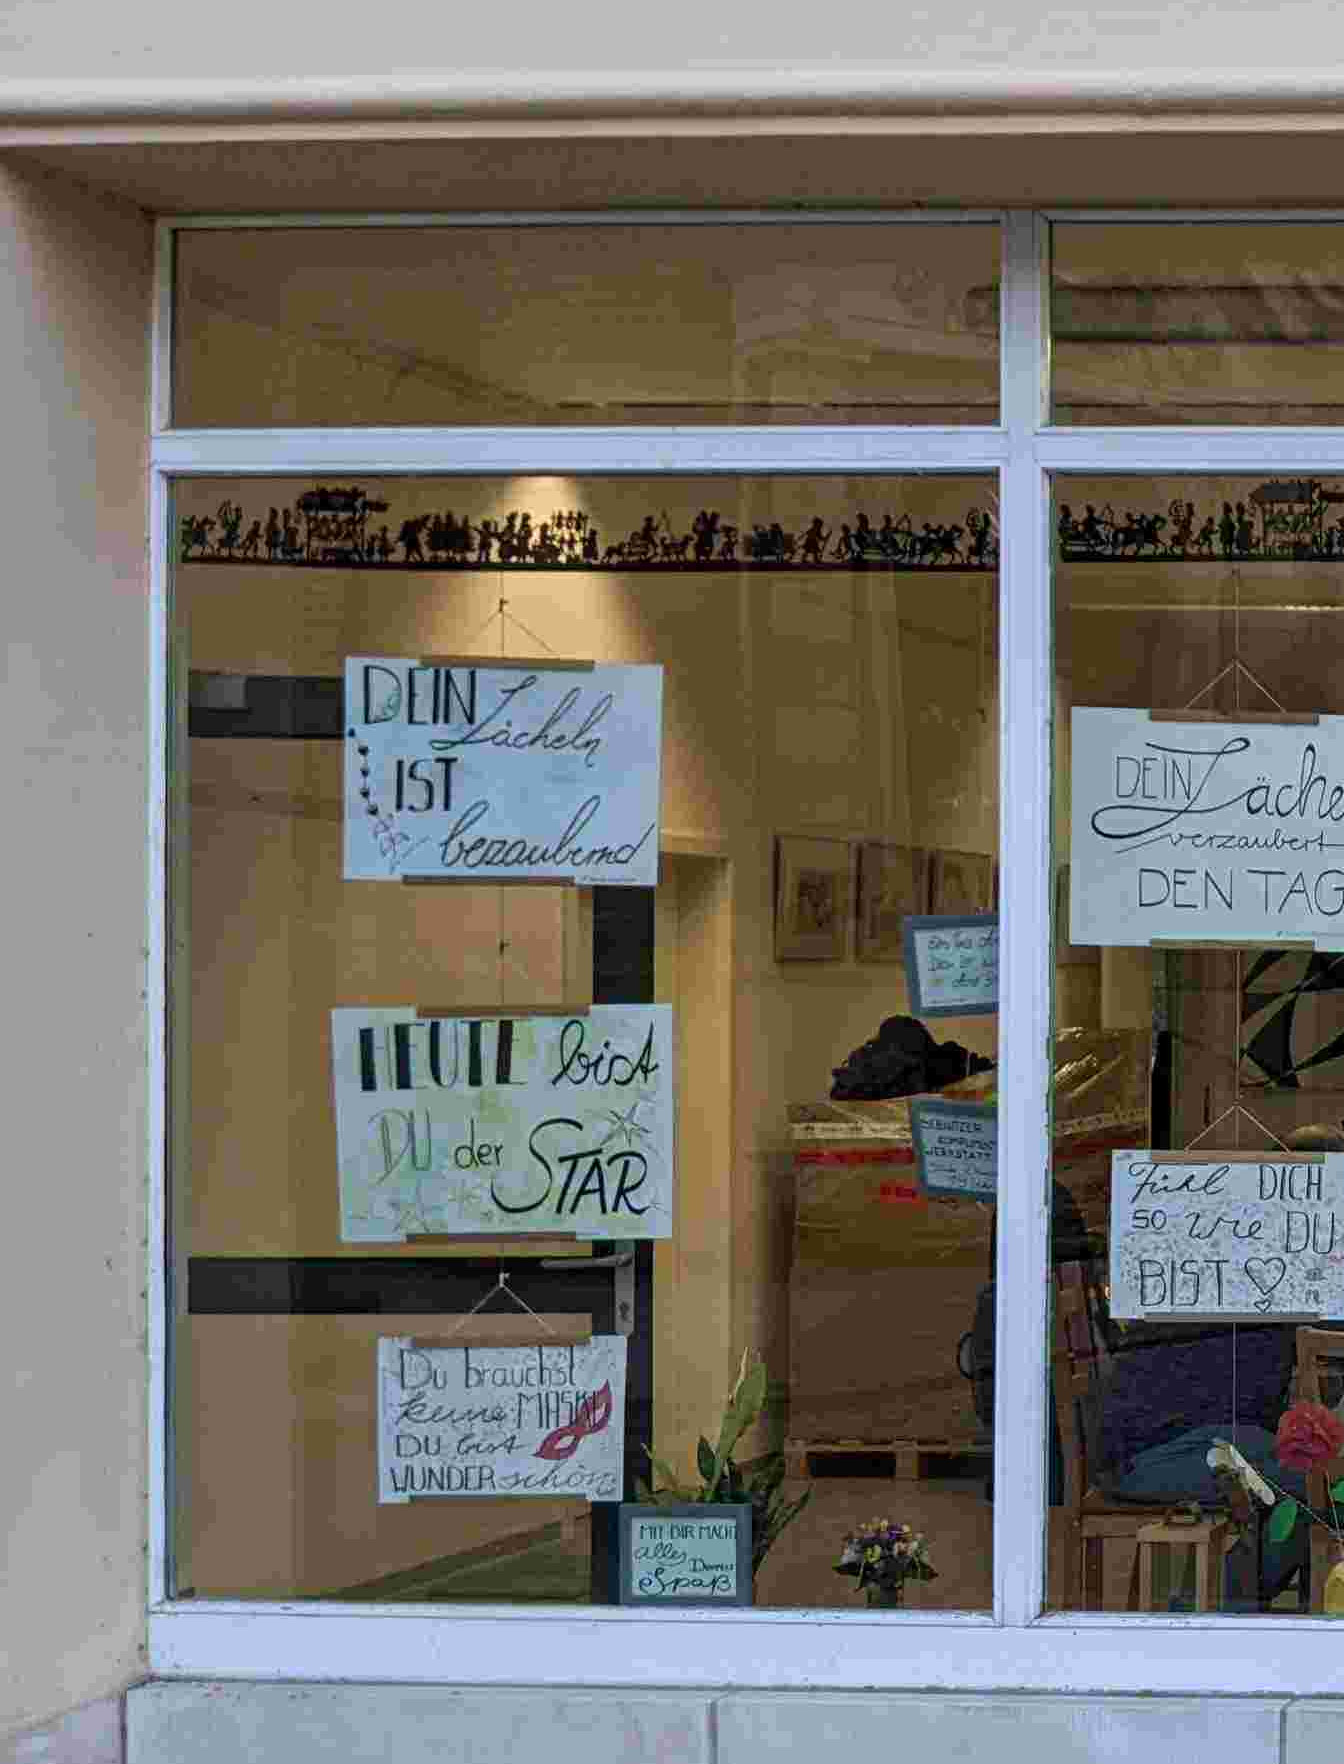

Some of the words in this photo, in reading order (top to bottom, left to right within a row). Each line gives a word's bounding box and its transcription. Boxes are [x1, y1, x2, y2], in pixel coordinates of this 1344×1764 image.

[362, 664, 477, 725] DEIN
[429, 674, 613, 768] Lächeln
[394, 756, 459, 813] IST
[1115, 756, 1192, 801] DEIN
[439, 795, 656, 868] bezaubernd
[1165, 828, 1330, 852] verzaubert
[1138, 867, 1233, 911] DEN
[358, 1018, 528, 1092] HEUTE
[551, 1019, 660, 1087] bist
[368, 1108, 433, 1187] DU
[454, 1113, 504, 1171] der
[489, 1117, 652, 1216] STAR
[1259, 1164, 1323, 1201] DICH
[1286, 1210, 1336, 1255] DU
[1139, 1259, 1230, 1308] BIST
[400, 1348, 448, 1390] Du
[463, 1345, 578, 1389] brauchst
[395, 1433, 442, 1459] DU
